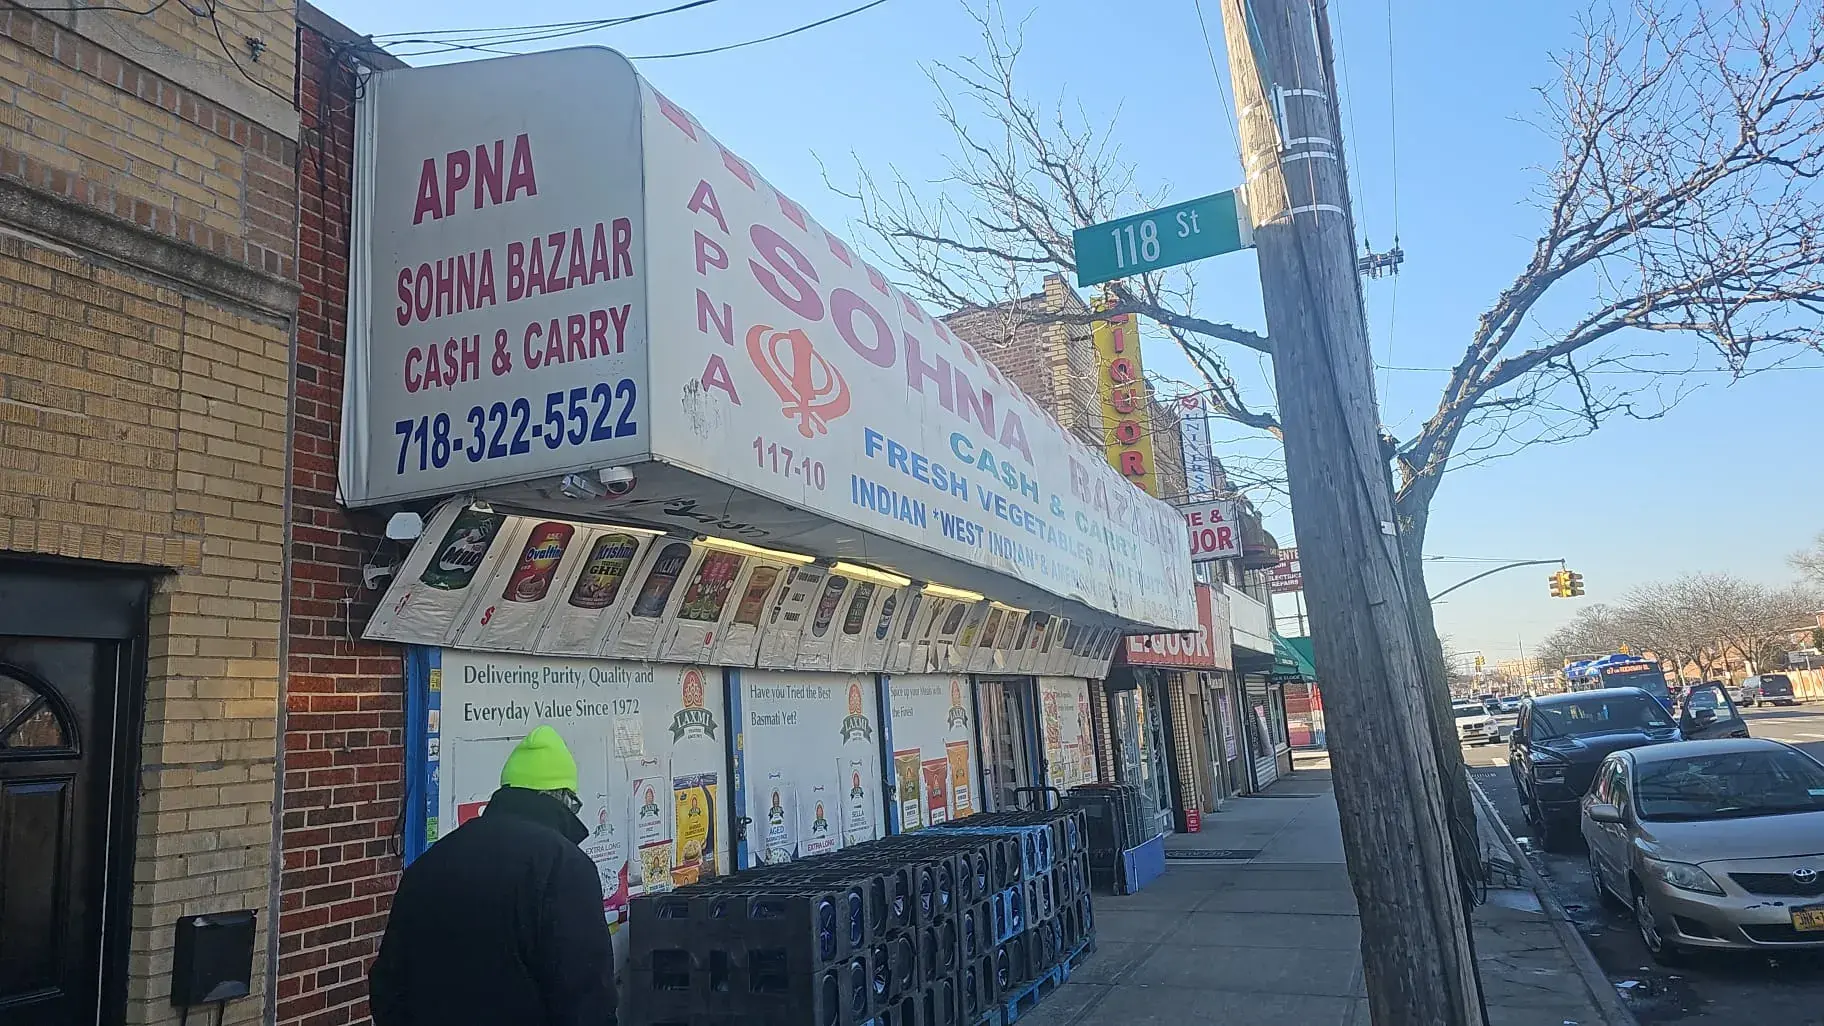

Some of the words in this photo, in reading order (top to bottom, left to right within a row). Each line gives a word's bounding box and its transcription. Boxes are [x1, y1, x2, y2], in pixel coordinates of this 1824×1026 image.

[412, 132, 538, 226] APNA
[1111, 219, 1161, 269] 118
[1175, 208, 1201, 239] St
[396, 251, 497, 327] SOHNA
[506, 217, 635, 303] BAZAAR
[686, 179, 742, 407] APNA
[403, 333, 481, 393] CA$H
[491, 327, 513, 376] &
[522, 303, 632, 371] CARRY
[747, 223, 1036, 467] SOHNA
[395, 377, 638, 475] 718-322-5522
[752, 435, 826, 491] 117-10
[850, 473, 928, 530] INDIAN
[863, 426, 969, 503] FRESH
[975, 483, 1093, 566] VEGETABLES
[1049, 494, 1066, 521] &
[1210, 509, 1224, 524] &
[463, 664, 540, 690] Delivering
[543, 665, 586, 689] Purity,
[589, 665, 632, 688] Quality
[634, 665, 654, 683] and
[750, 684, 770, 699] Have
[771, 686, 785, 702] you
[786, 685, 805, 699] Tried
[806, 685, 817, 699] the
[818, 686, 832, 700] Best
[463, 700, 531, 726] Everyday
[534, 699, 573, 718] Value
[576, 698, 609, 717] Since
[612, 698, 640, 715] 1972
[676, 711, 710, 728] LAXMI
[751, 710, 781, 726] Basmati
[781, 710, 797, 725] Yet?
